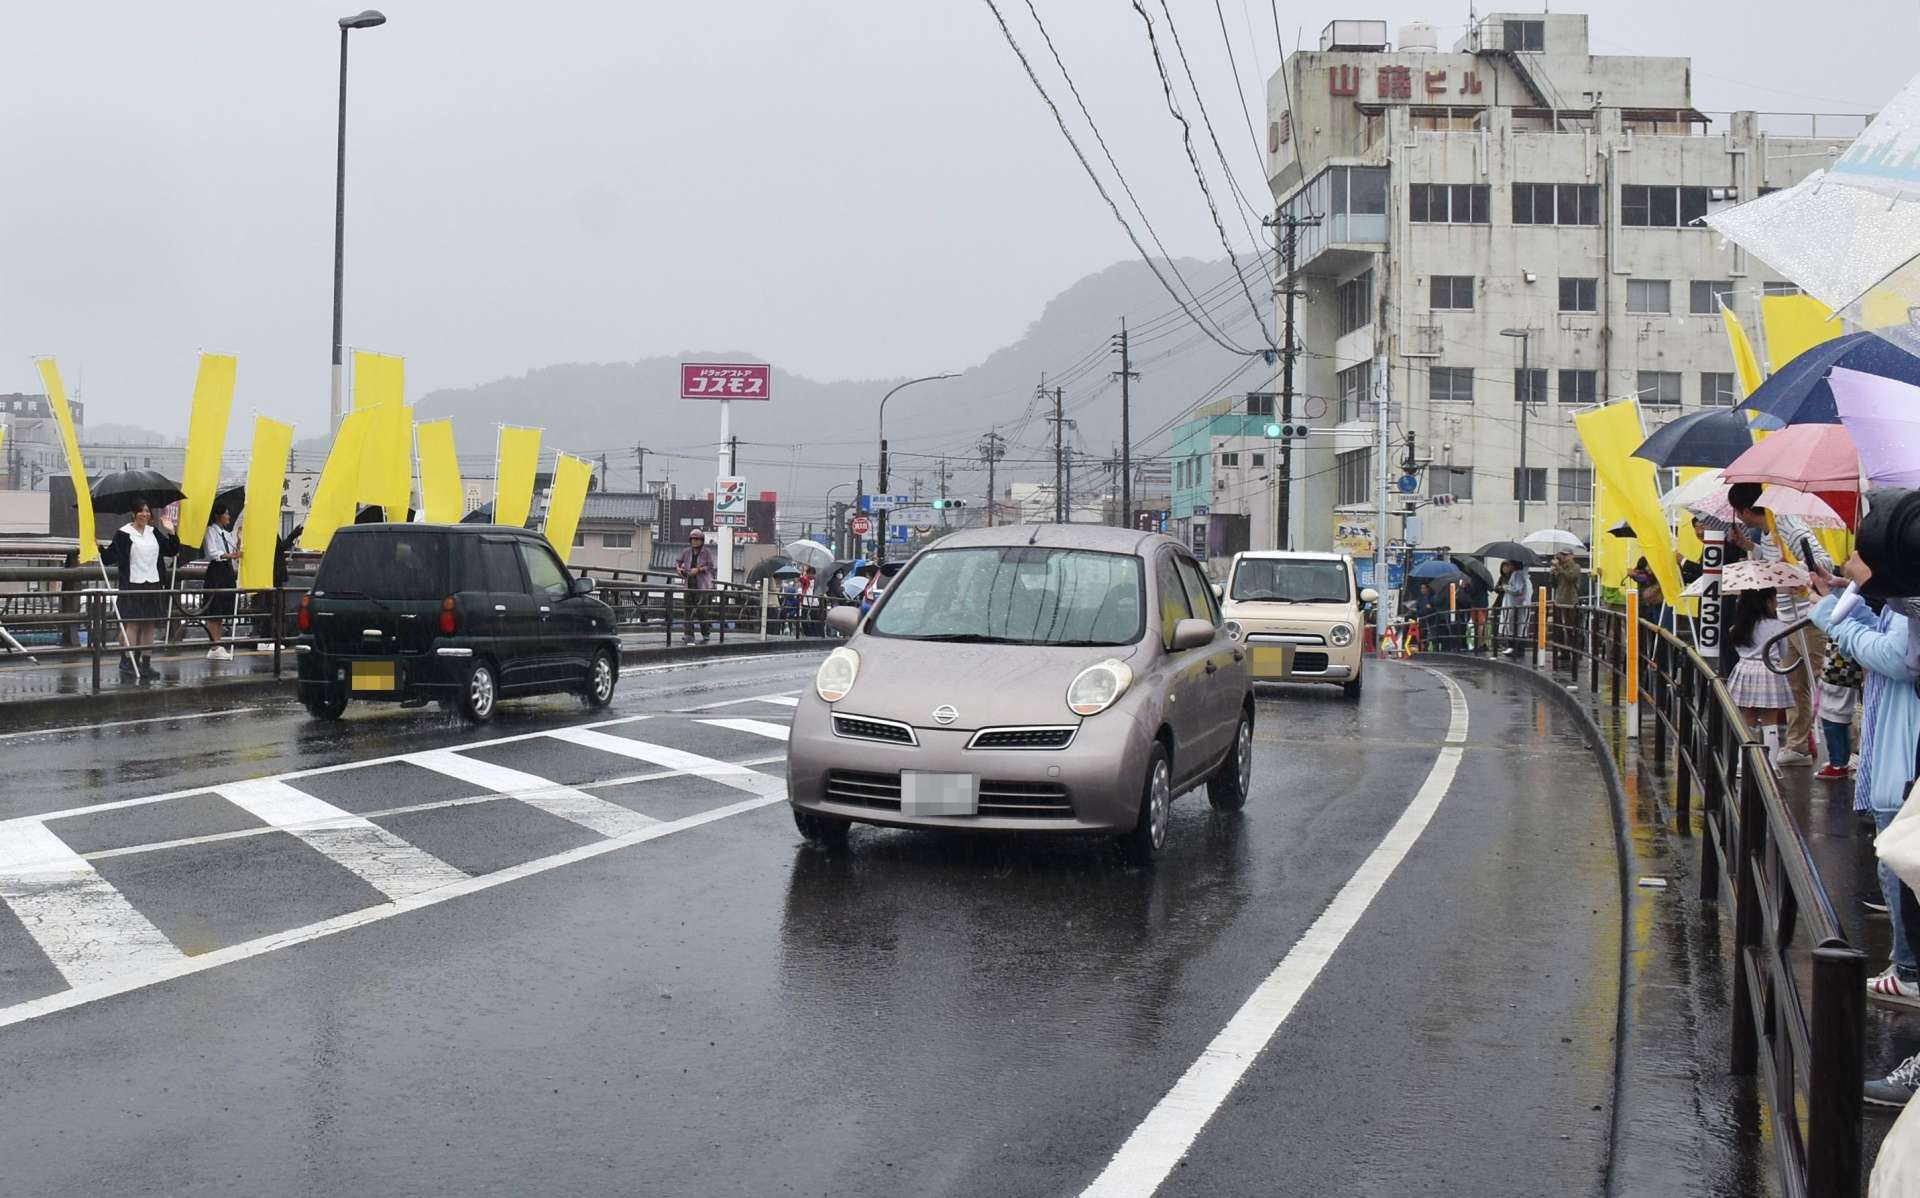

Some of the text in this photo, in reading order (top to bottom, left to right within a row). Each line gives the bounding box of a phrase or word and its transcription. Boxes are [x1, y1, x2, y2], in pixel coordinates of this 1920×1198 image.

[700, 369, 752, 377] ドラッグストア
[689, 377, 763, 393] コスモス
